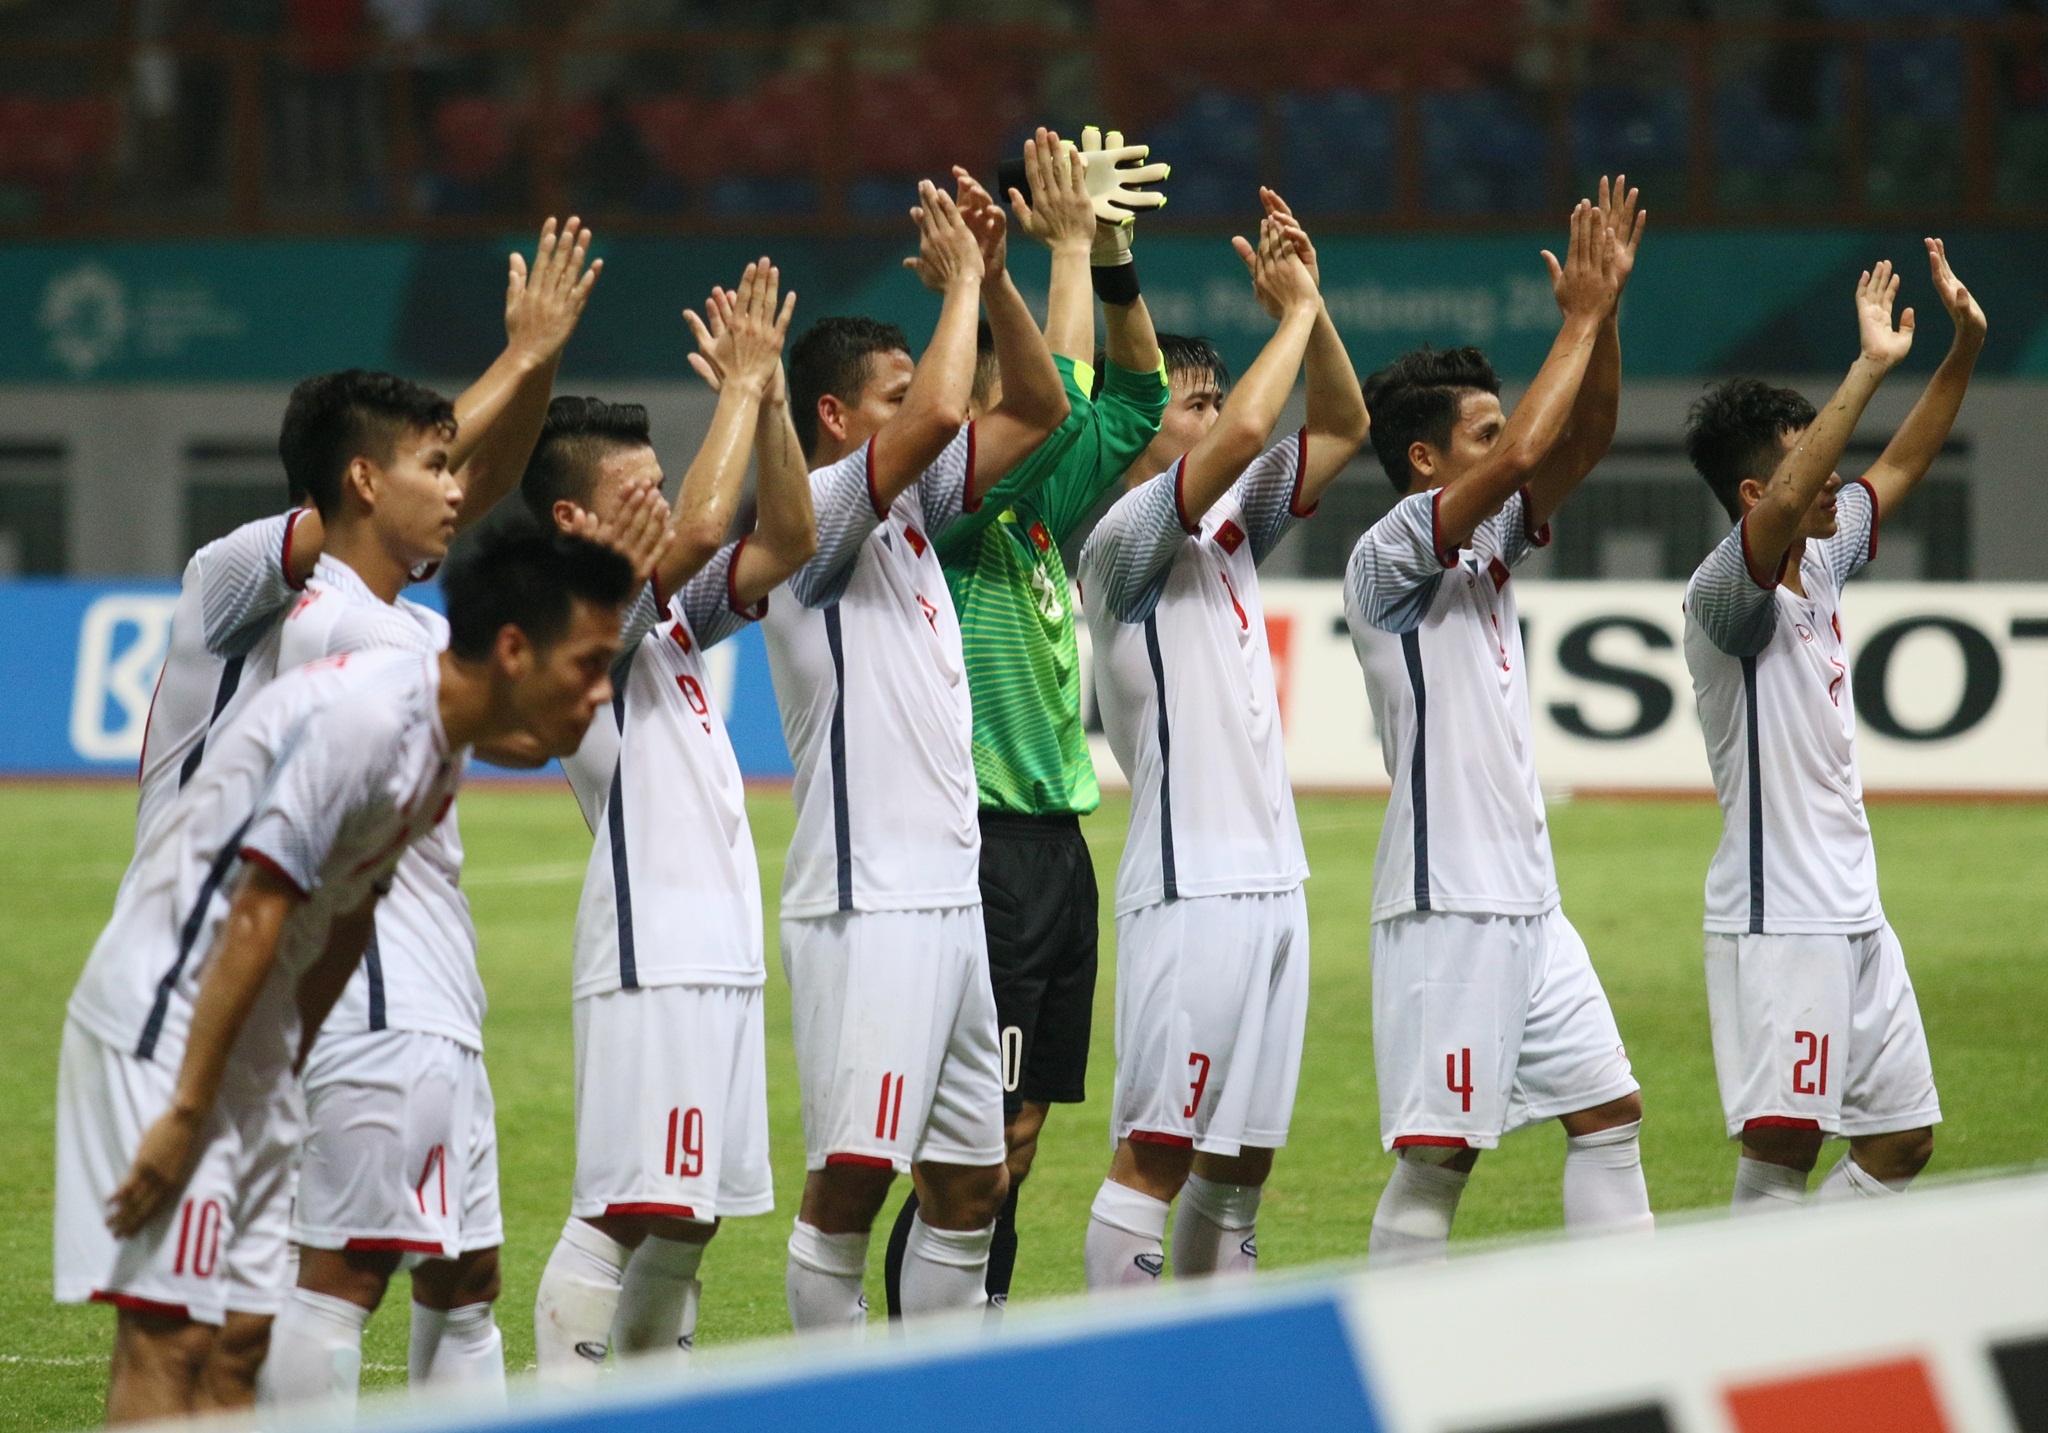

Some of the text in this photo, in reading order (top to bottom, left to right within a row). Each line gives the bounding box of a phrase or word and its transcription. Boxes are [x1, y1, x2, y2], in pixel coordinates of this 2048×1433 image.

[1184, 1052, 1210, 1118] 3
[1447, 1048, 1474, 1112] 4
[1793, 1030, 1829, 1096] 21
[875, 1071, 904, 1141] 11
[665, 1107, 703, 1177] 19
[172, 1197, 221, 1279] 10
